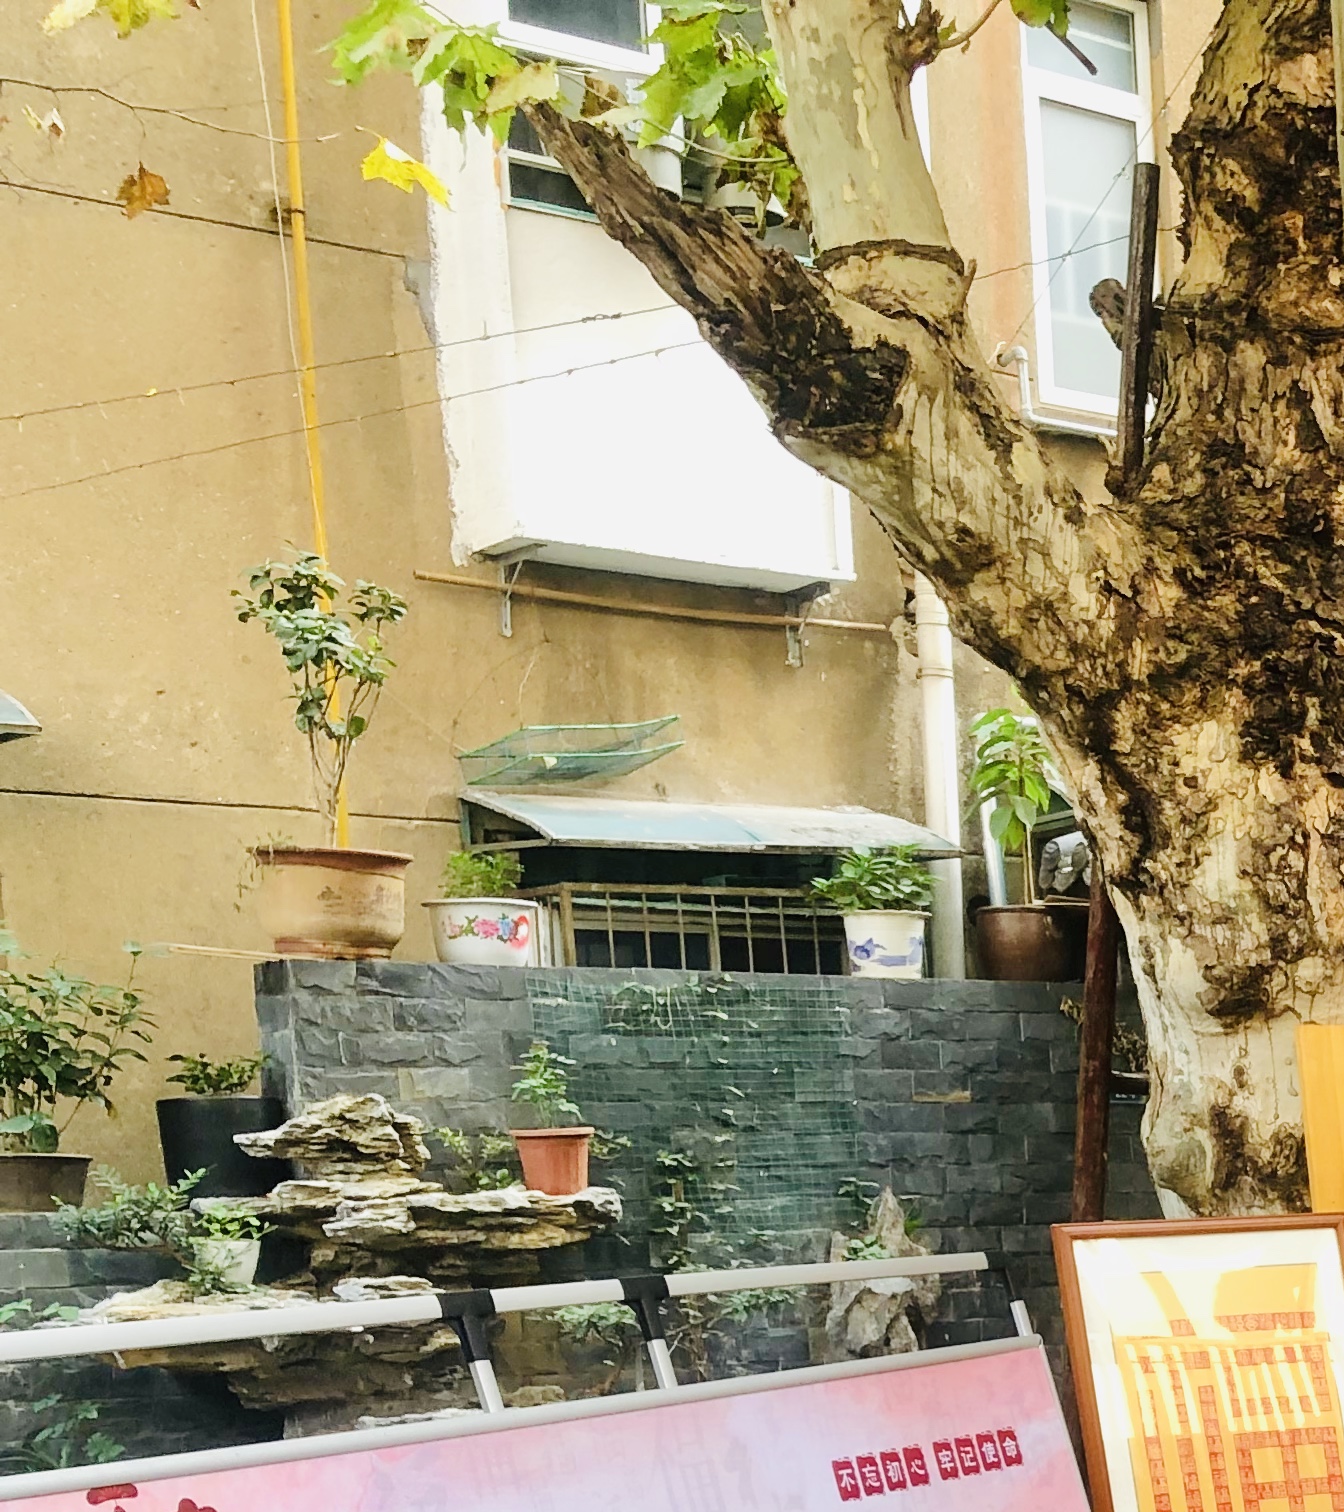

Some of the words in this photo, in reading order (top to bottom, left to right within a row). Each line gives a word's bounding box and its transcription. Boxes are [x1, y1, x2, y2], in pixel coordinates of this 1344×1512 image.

[835, 1454, 928, 1497] 不忘初心
[935, 1433, 1020, 1476] 牢记使命
